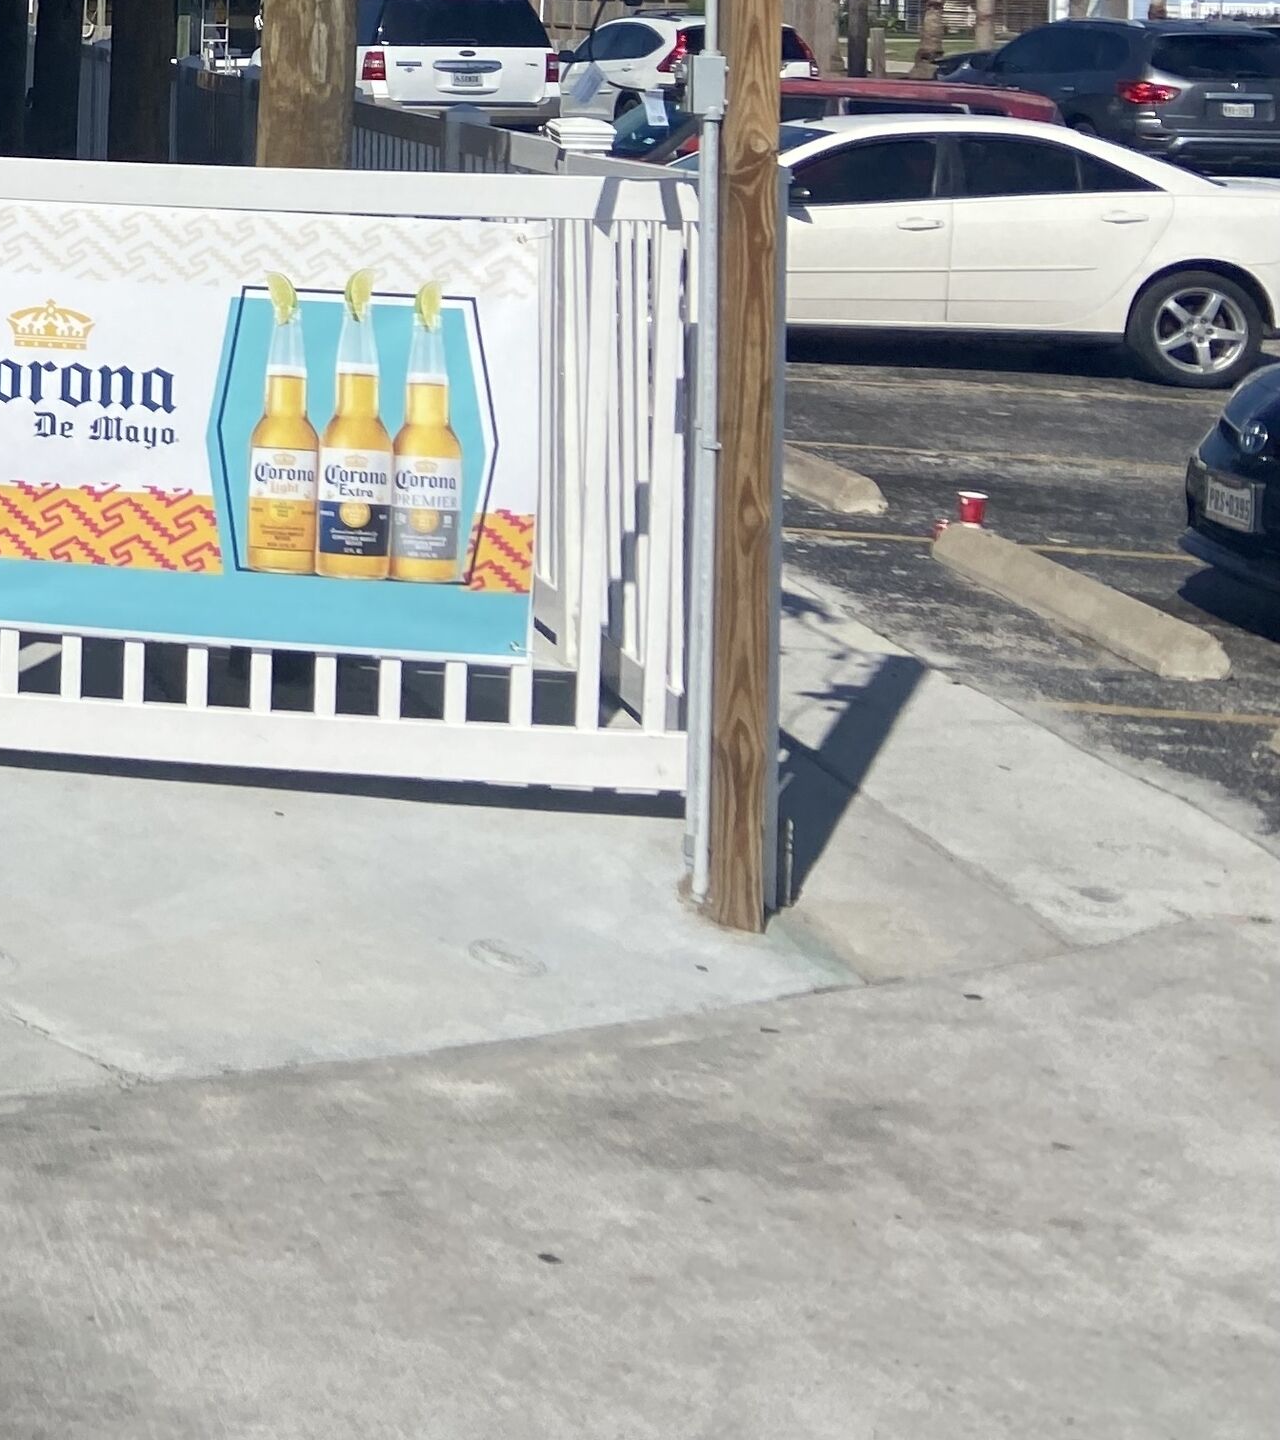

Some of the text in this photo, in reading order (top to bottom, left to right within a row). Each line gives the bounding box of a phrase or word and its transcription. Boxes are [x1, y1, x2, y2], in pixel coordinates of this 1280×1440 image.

[33, 411, 175, 450] De Mayo
[254, 461, 314, 485] Corona
[324, 463, 387, 488] Corona
[395, 469, 457, 493] Corona
[269, 482, 300, 495] Light
[339, 483, 374, 499] Extra
[395, 493, 458, 509] PREMIER
